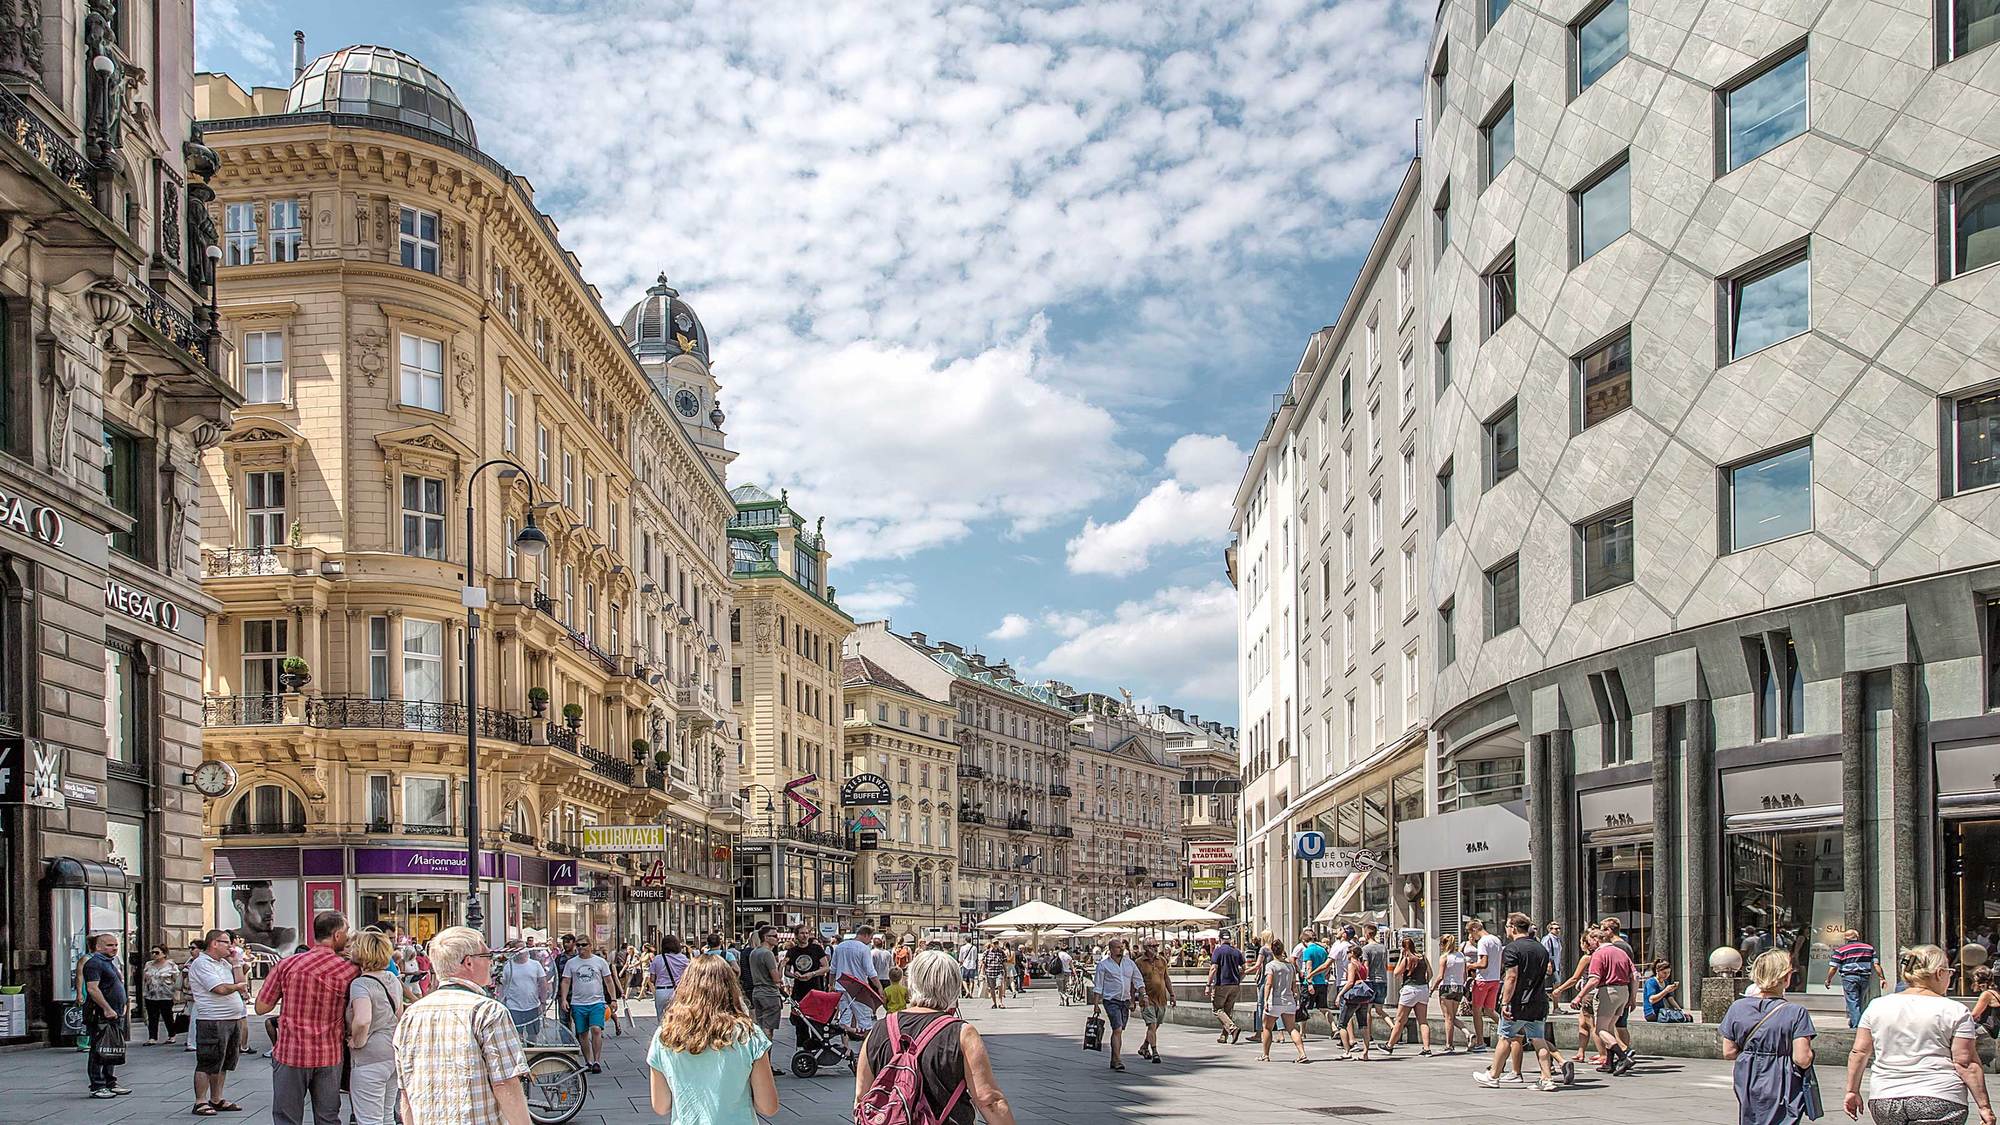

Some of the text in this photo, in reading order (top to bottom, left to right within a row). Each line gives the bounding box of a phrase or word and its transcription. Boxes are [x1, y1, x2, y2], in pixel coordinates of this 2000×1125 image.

[853, 792, 880, 800] BUFFET
[589, 828, 659, 846] STURMAYR
[1302, 836, 1321, 855] U
[1466, 840, 1489, 853] ZARA
[408, 853, 467, 867] Marionnaud
